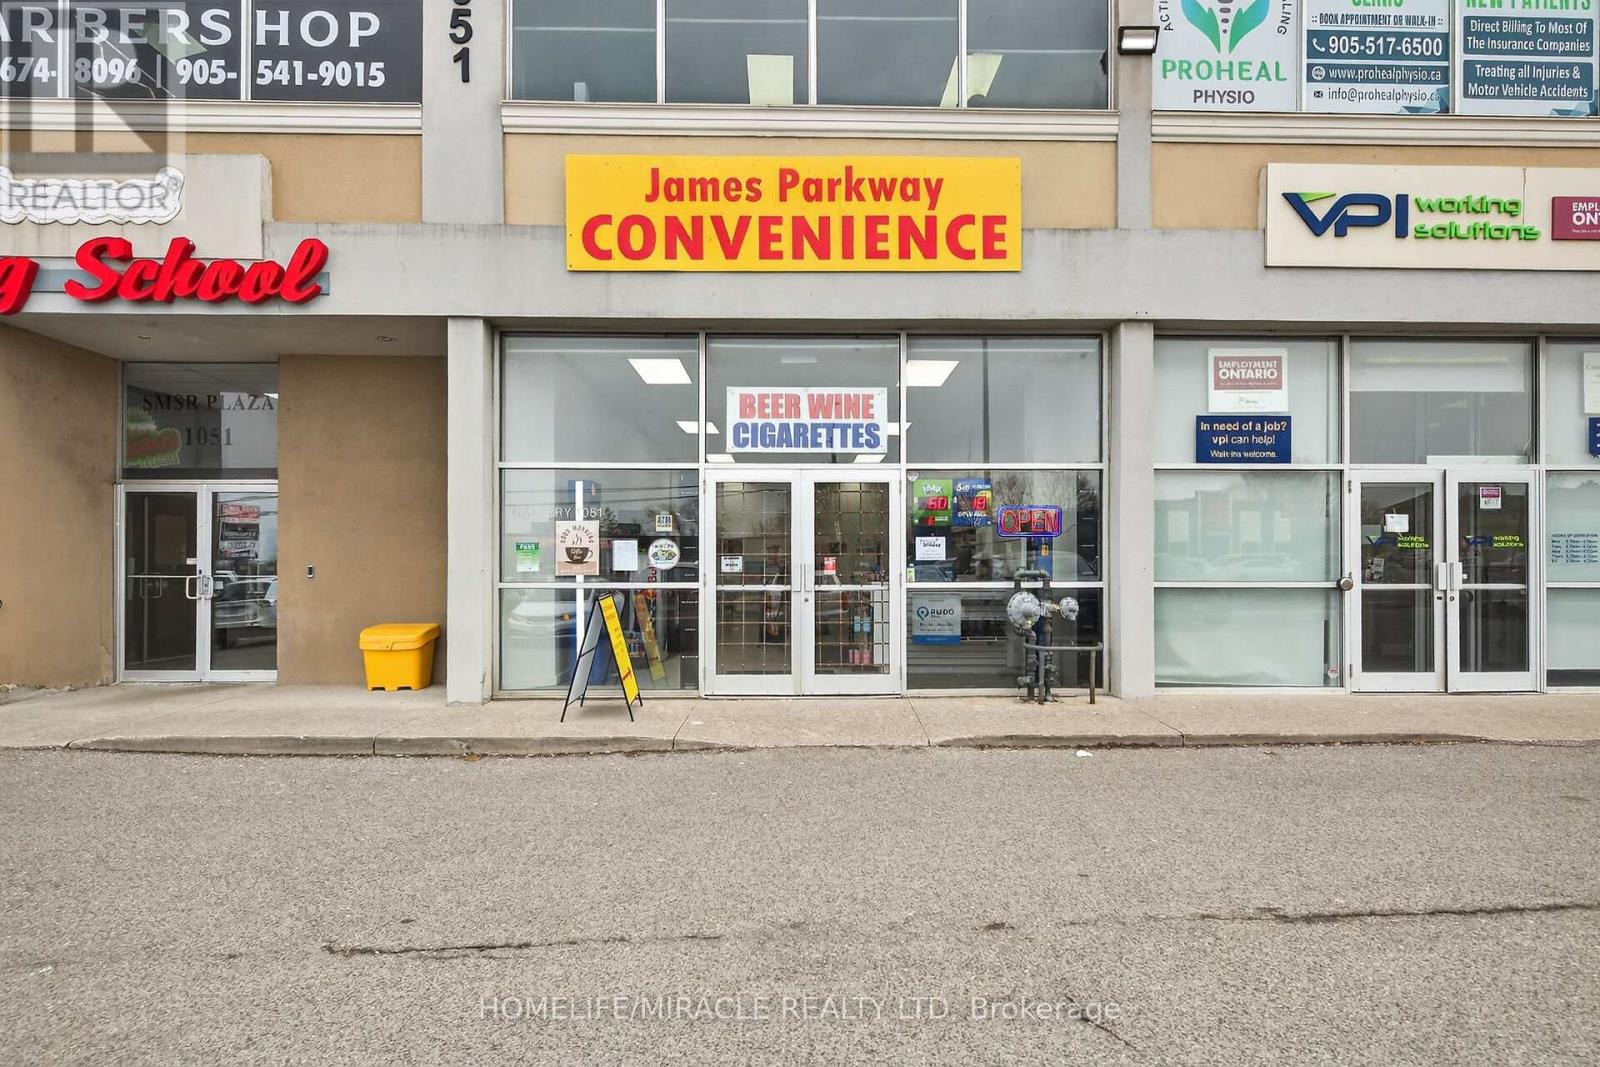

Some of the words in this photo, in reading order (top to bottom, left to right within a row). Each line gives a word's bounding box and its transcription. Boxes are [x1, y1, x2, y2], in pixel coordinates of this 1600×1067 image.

[1340, 14, 1392, 26] APPOINTMENT
[1393, 15, 1403, 26] OR
[1405, 15, 1436, 27] WALK-IN
[1470, 20, 1500, 33] Direct
[1502, 20, 1533, 35] Billing
[1535, 21, 1546, 33] To
[1548, 22, 1573, 34] Most
[1575, 22, 1587, 34] Of
[449, 0, 473, 82] 51
[1329, 36, 1443, 56] 905-517-6500
[1467, 36, 1485, 49] The
[1487, 37, 1534, 50] Insurance
[1537, 38, 1590, 53] Companies
[1161, 59, 1288, 81] PROHEAL
[1328, 66, 1441, 84] www.prohealphysio.ca
[1475, 64, 1516, 80] Treating
[1518, 64, 1530, 78] all
[1533, 66, 1570, 81] Injuries
[1572, 66, 1581, 79] &
[1193, 89, 1255, 104] PHYSIO
[1328, 87, 1440, 104] info@prohealphysio.ca
[1468, 83, 1500, 96] Motor
[1501, 83, 1538, 97] Vehicle
[1540, 84, 1588, 98] Accidents
[645, 168, 762, 203] James
[780, 165, 943, 209] Parkway
[1414, 195, 1522, 217] working
[1572, 212, 1600, 226] ON
[582, 213, 1008, 261] CONVENIENCE
[1414, 219, 1542, 242] solutions
[64, 237, 330, 303] School
[1218, 360, 1278, 369] EMPLOYMENT
[1218, 368, 1278, 380] ONTARIO
[143, 393, 198, 411] SMSR
[207, 393, 274, 411] PLAZA
[739, 393, 802, 420] BEER
[807, 393, 876, 420] WINE
[186, 427, 233, 446] 1051
[732, 422, 881, 448] CIGARETTES
[1200, 422, 1210, 431] In
[1213, 422, 1239, 431] need
[1242, 422, 1254, 431] of
[1263, 422, 1287, 433] job?
[1231, 436, 1250, 446] can
[1251, 435, 1276, 447] help!
[1001, 509, 1059, 533] OPEN
